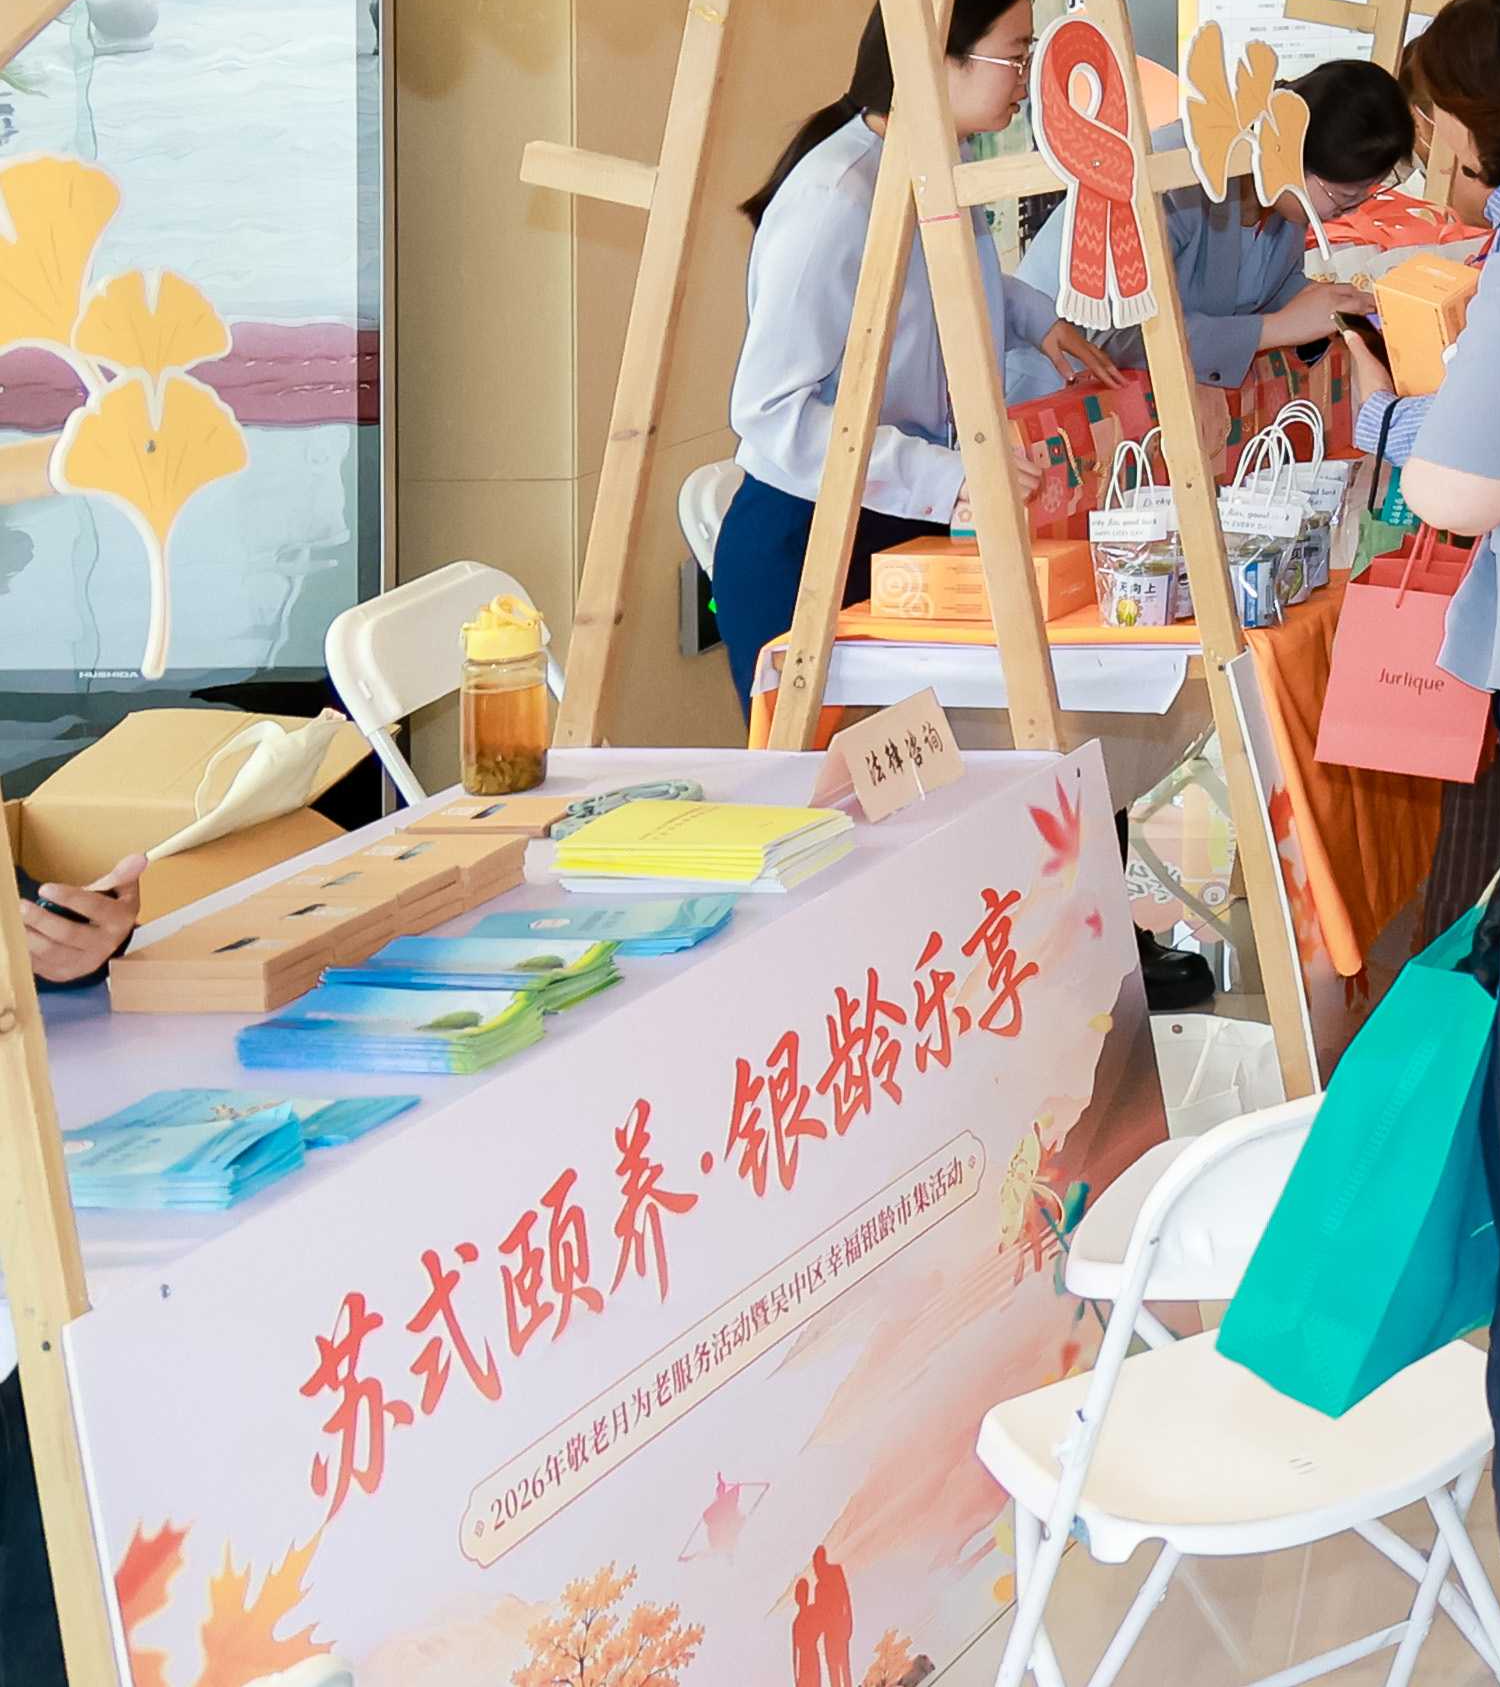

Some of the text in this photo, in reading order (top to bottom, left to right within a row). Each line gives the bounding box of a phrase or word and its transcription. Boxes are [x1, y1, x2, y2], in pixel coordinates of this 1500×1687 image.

[1379, 668, 1445, 696] Jurlique
[865, 720, 944, 787] 法律咨询
